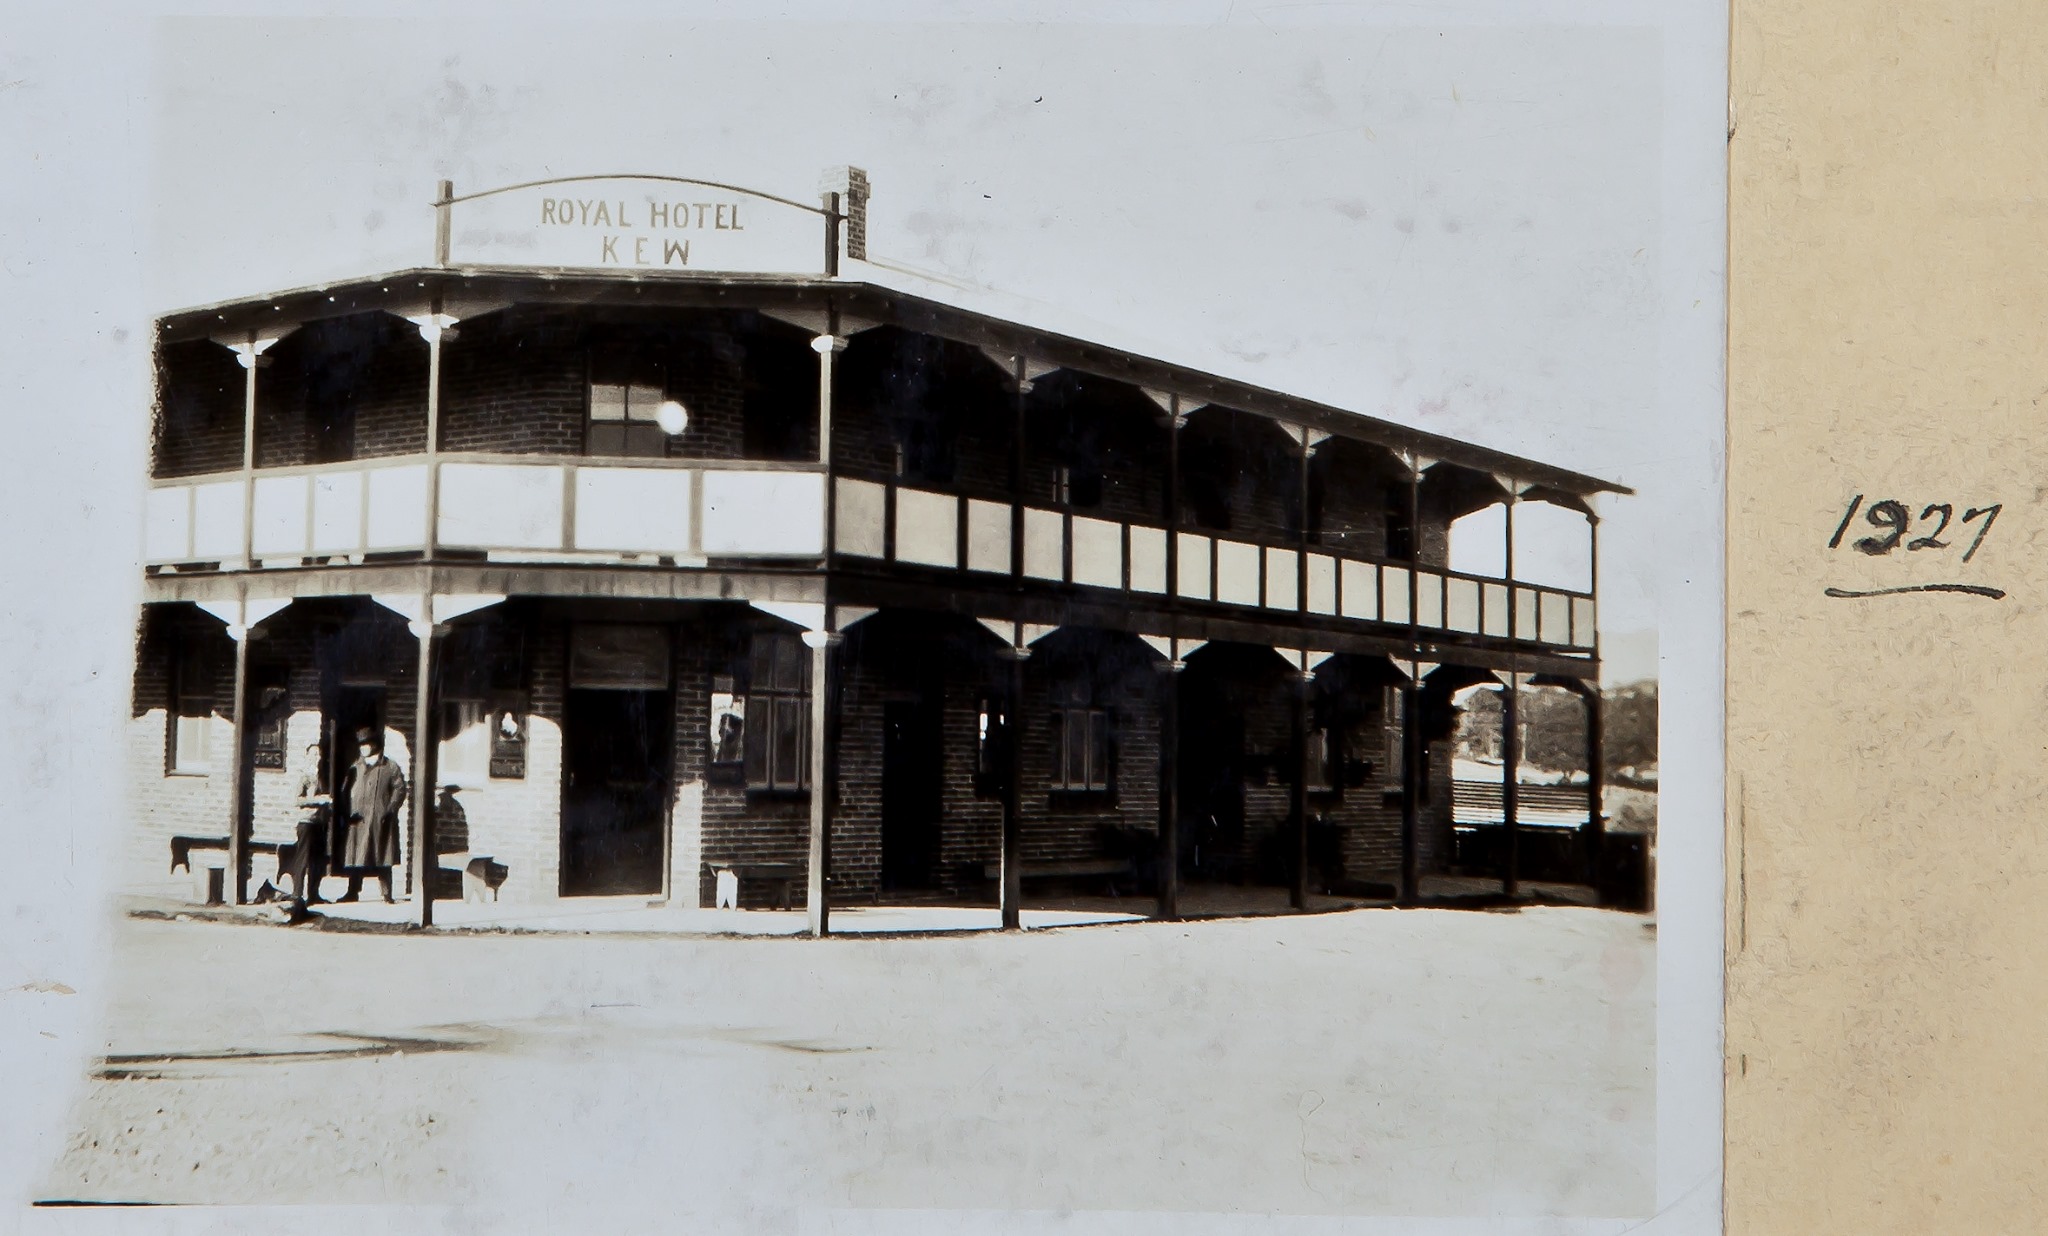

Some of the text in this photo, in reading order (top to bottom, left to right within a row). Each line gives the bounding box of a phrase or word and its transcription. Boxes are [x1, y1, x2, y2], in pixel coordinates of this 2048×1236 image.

[541, 199, 744, 230] ROYAL HOTEL
[602, 236, 690, 266] KEW
[1828, 494, 2003, 563] 1927
